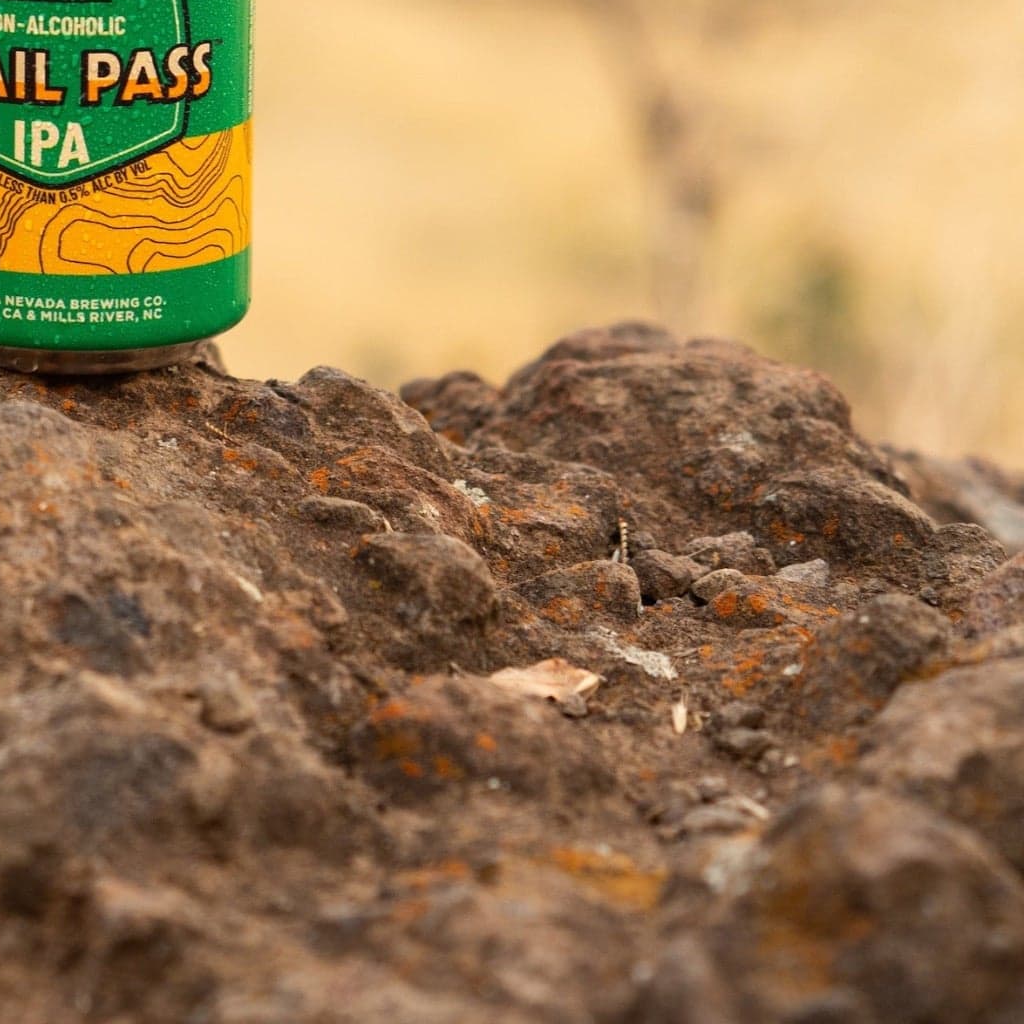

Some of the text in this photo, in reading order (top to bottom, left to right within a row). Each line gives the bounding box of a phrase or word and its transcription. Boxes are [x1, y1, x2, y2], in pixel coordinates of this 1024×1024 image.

[80, 41, 213, 106] PASS
[13, 120, 91, 169] IPA
[25, 187, 56, 204] THAN
[59, 185, 90, 204] 0.5%
[91, 175, 114, 193] ALC
[114, 168, 129, 184] BY
[129, 160, 153, 177] VOL
[2, 308, 23, 321] CA
[26, 310, 37, 321] &
[41, 310, 85, 323] MILLS
[89, 310, 139, 324] RIVER,
[143, 308, 163, 320] NC
[5, 294, 66, 310] NEVADA
[70, 296, 140, 310] BREWING
[143, 295, 168, 308] CO.
